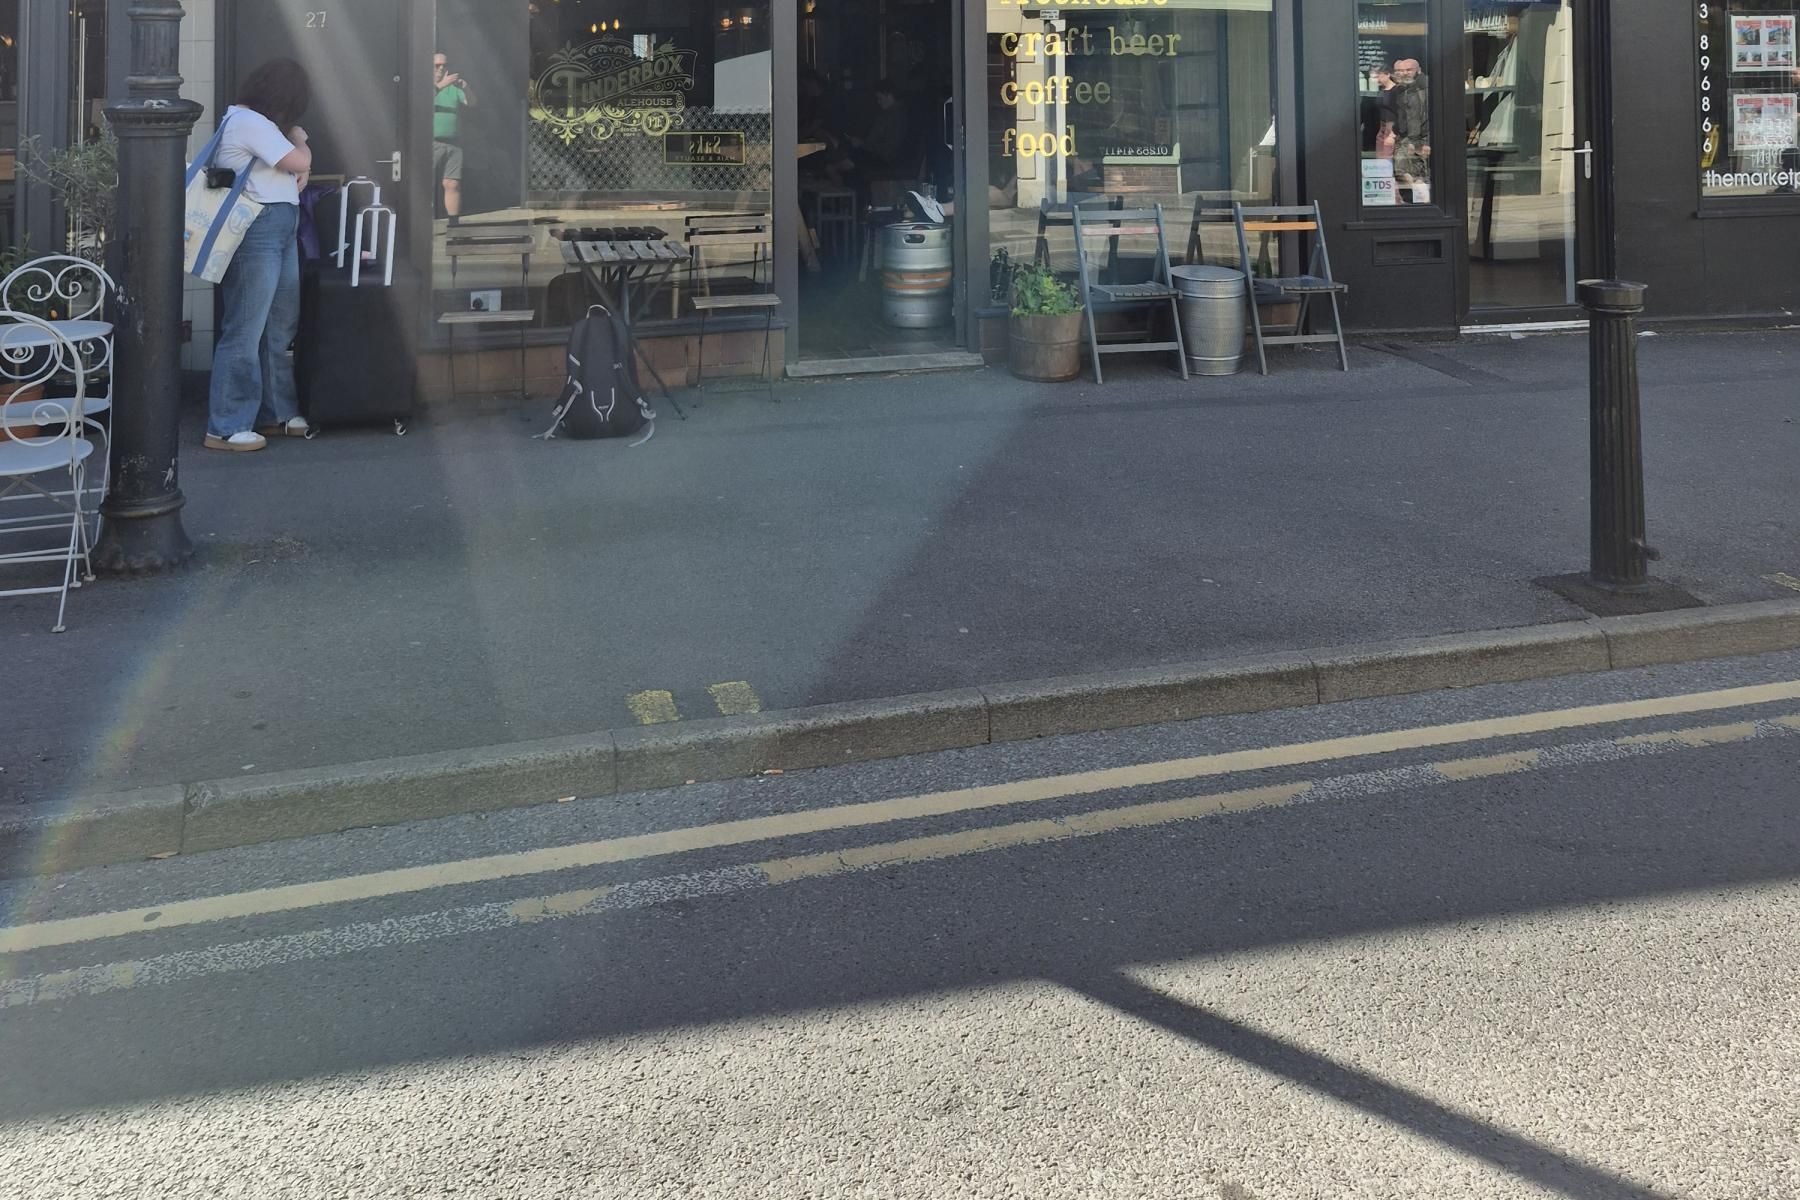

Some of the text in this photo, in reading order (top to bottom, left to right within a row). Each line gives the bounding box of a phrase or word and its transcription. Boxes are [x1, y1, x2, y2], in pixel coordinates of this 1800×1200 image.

[304, 11, 326, 28] 27
[1000, 24, 1182, 57] craft beer
[617, 97, 674, 107] ALEHOUSE
[1000, 75, 1111, 106] coffee
[1002, 124, 1079, 158] food
[1372, 180, 1392, 190] TDS
